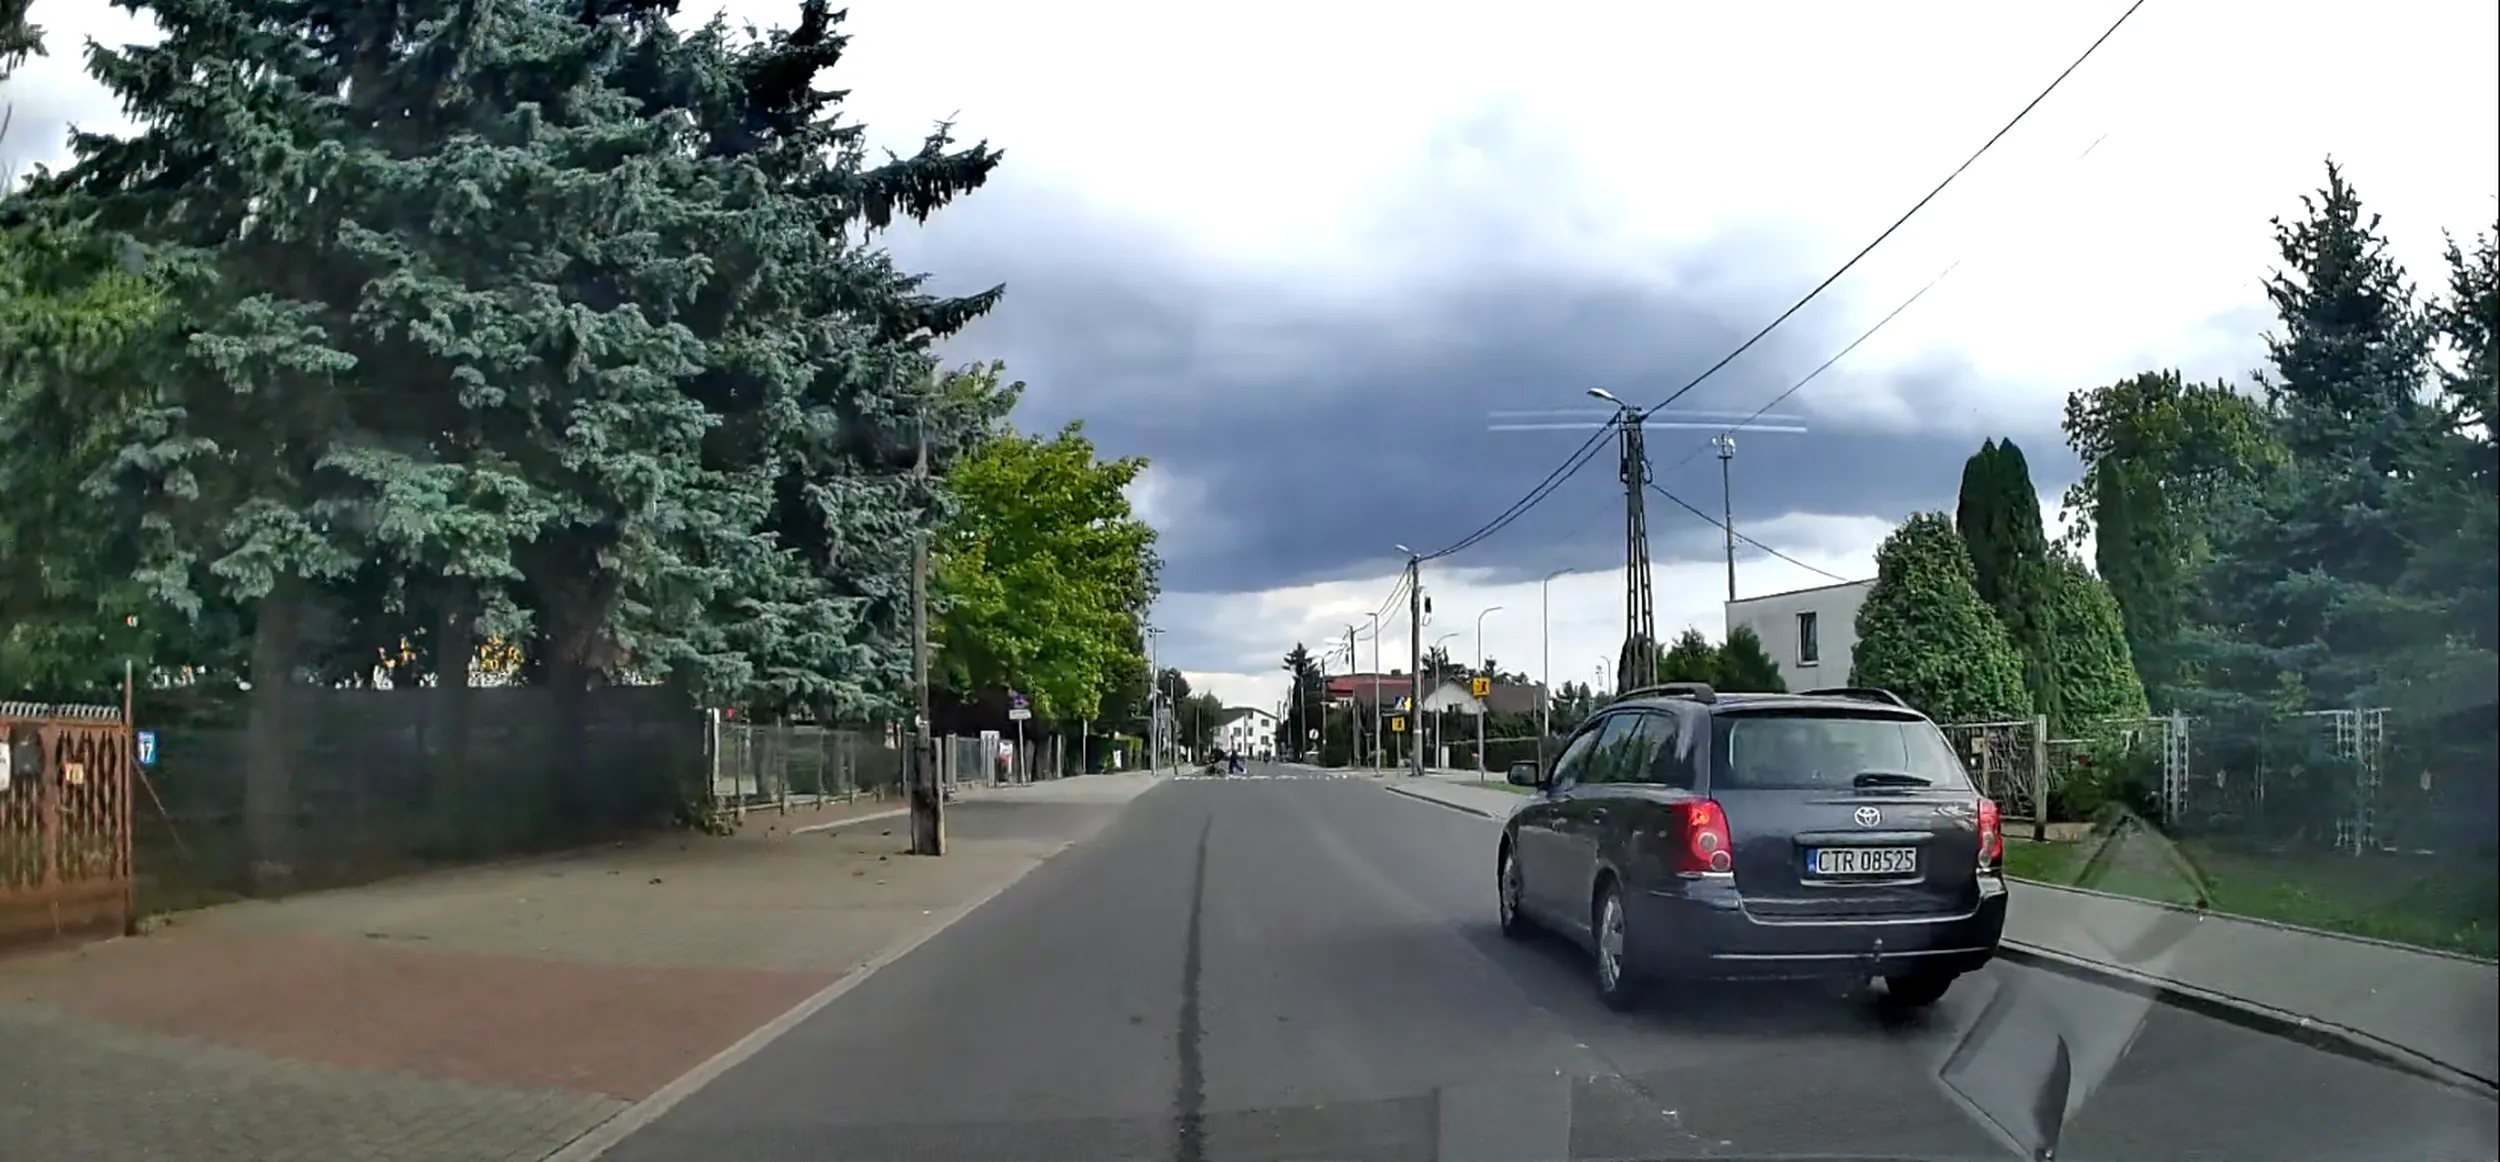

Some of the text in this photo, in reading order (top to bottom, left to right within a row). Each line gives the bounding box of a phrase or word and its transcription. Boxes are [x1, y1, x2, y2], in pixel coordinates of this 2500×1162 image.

[140, 742, 153, 763] 17
[1818, 850, 1914, 872] CTR 08525
